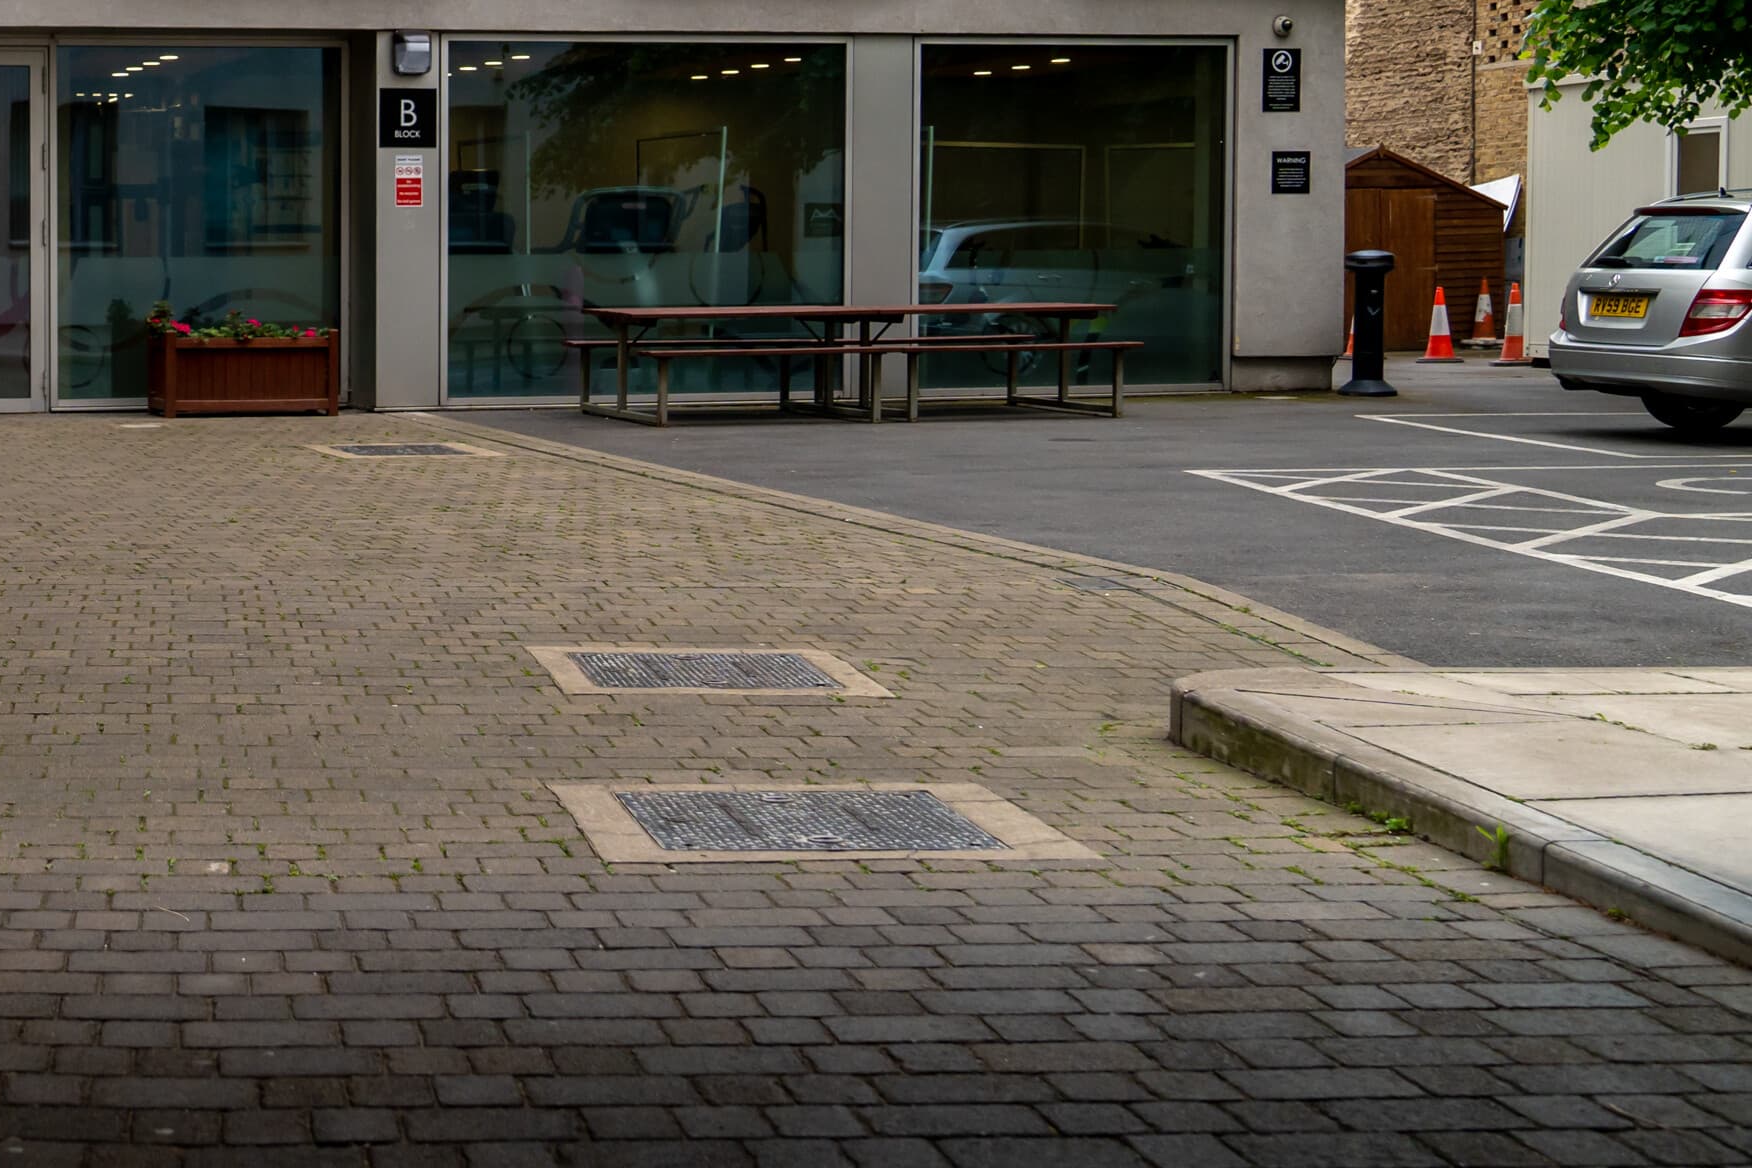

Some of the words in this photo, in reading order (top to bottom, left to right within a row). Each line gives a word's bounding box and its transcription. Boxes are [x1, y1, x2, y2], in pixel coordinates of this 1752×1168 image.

[400, 99, 417, 127] B
[394, 130, 421, 139] BLOCK
[1621, 298, 1643, 314] BGE
